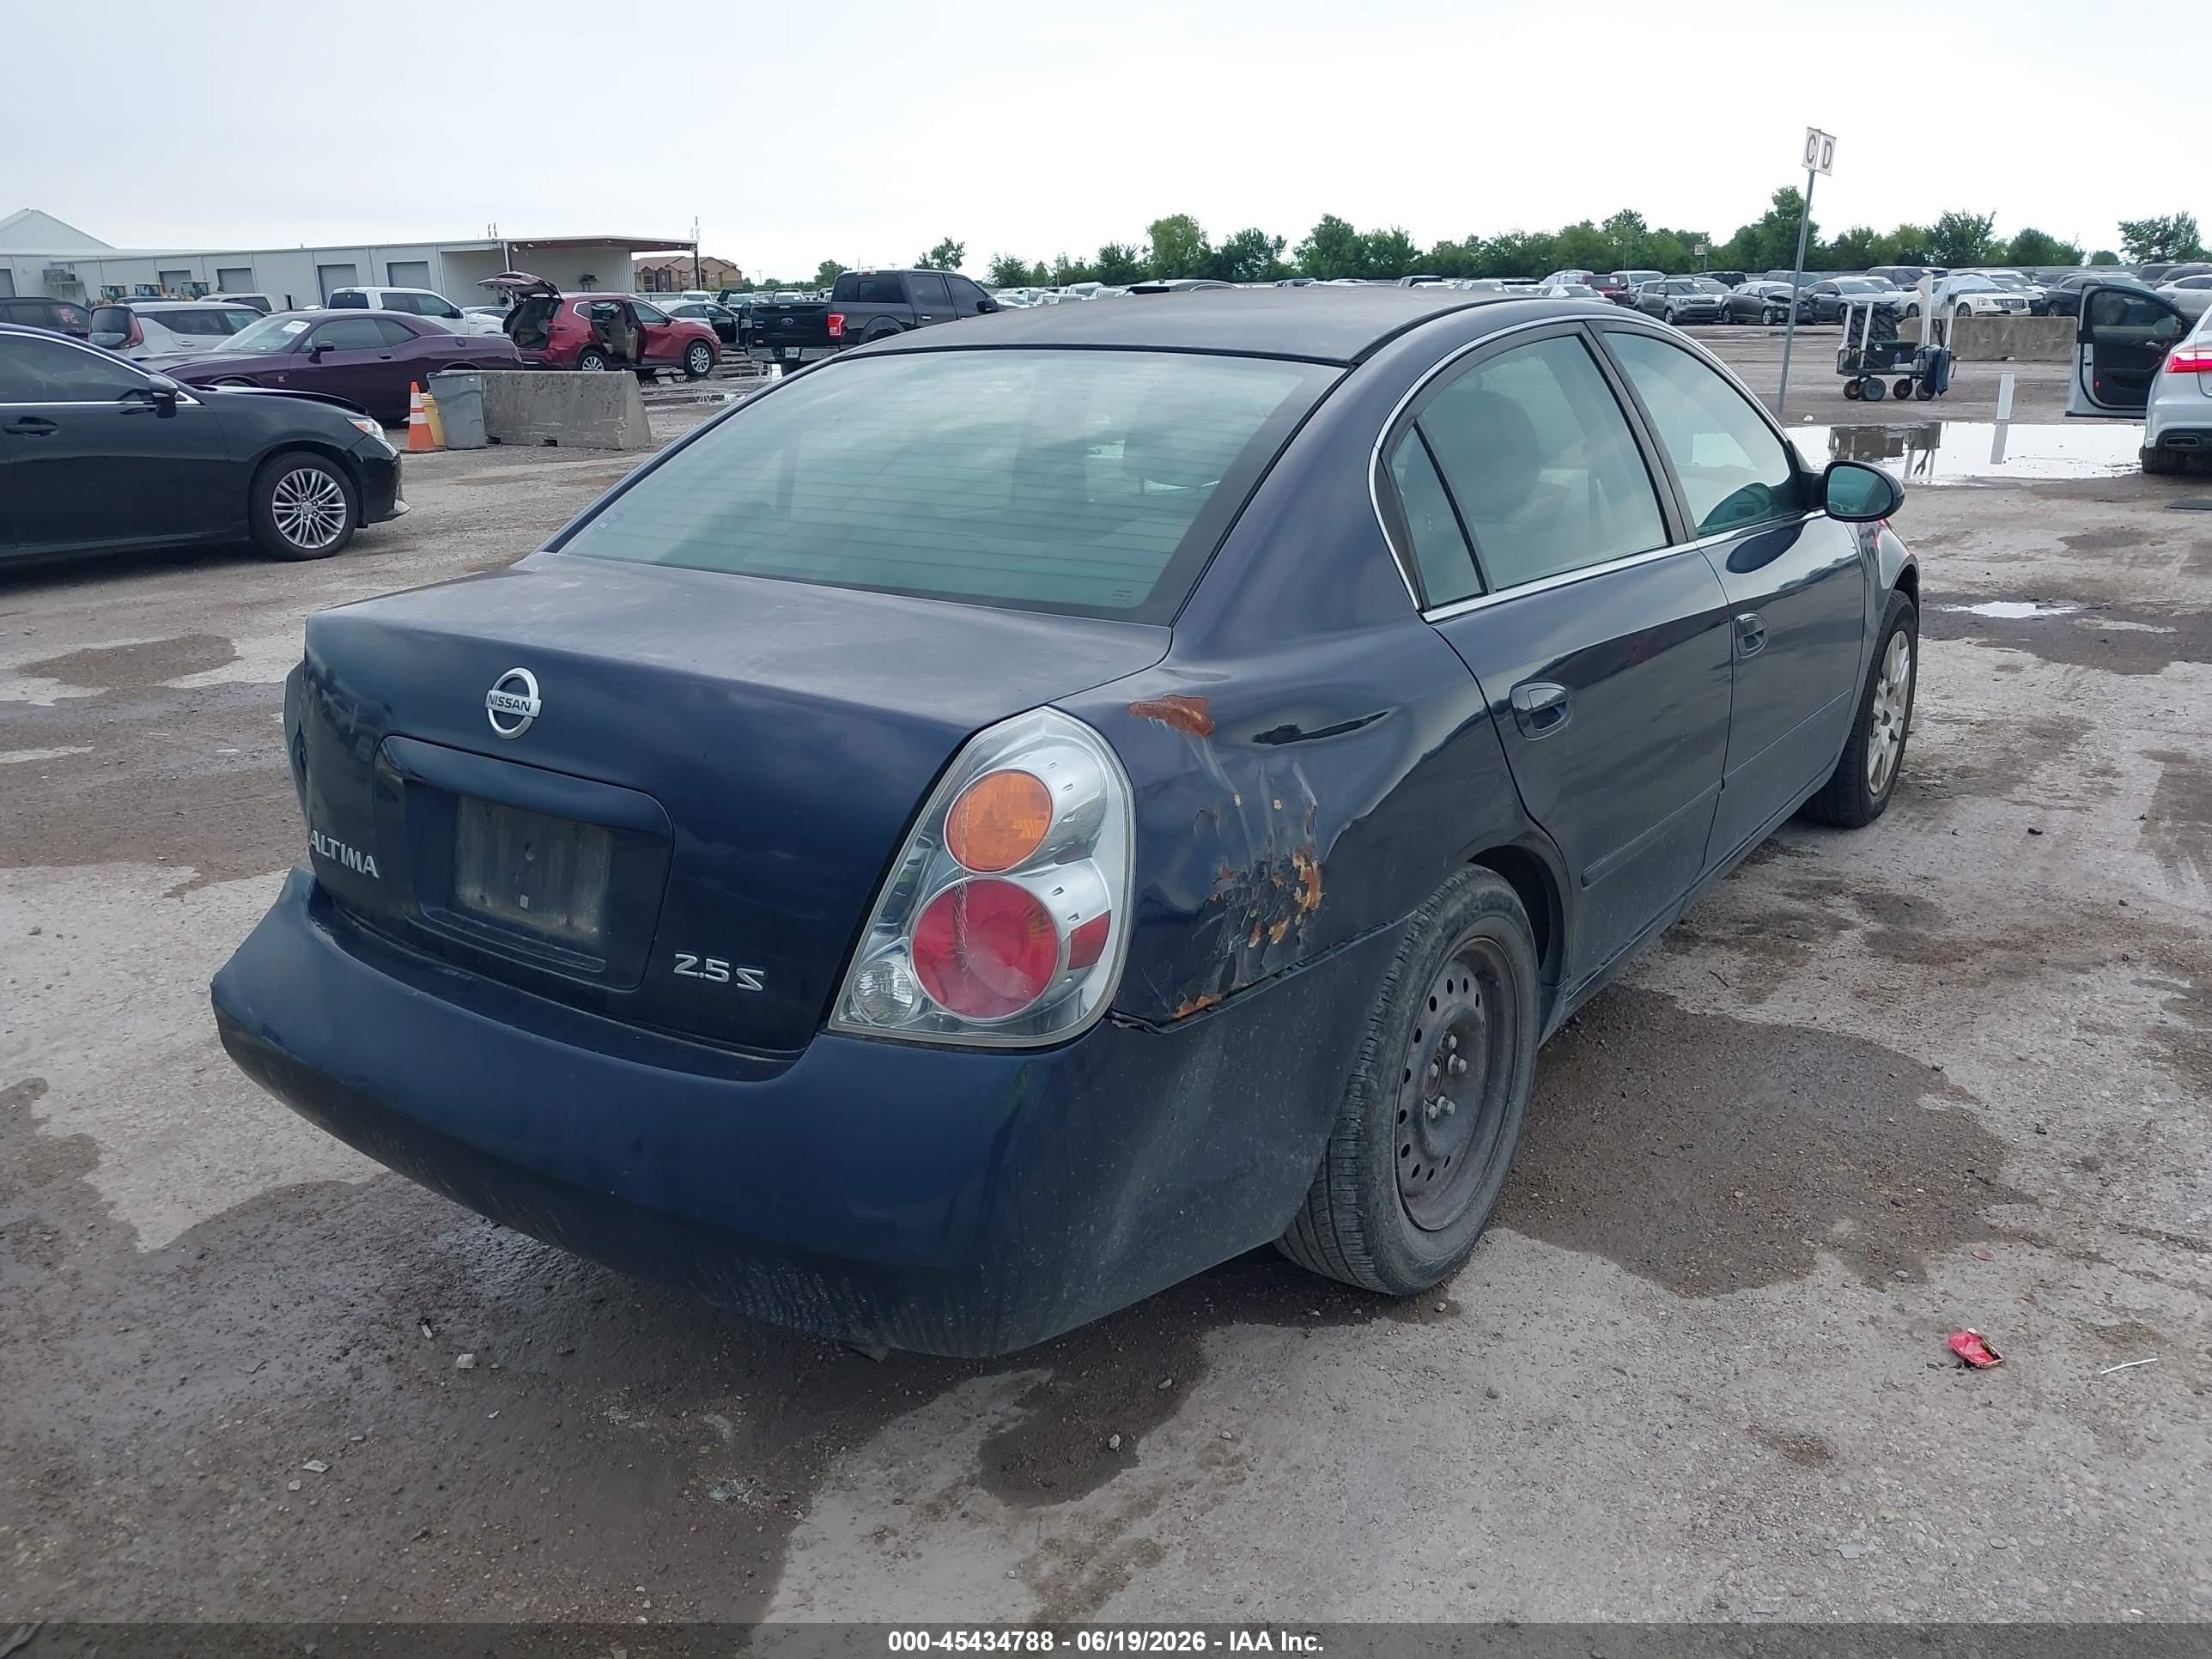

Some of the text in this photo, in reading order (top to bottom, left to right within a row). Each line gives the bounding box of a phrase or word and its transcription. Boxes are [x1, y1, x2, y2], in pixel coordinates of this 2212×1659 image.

[1806, 133, 1816, 164] C
[1821, 139, 1832, 169] D
[487, 693, 532, 712] NISSAN
[309, 830, 380, 878] ALTIMA
[673, 952, 764, 992] 2.5 S
